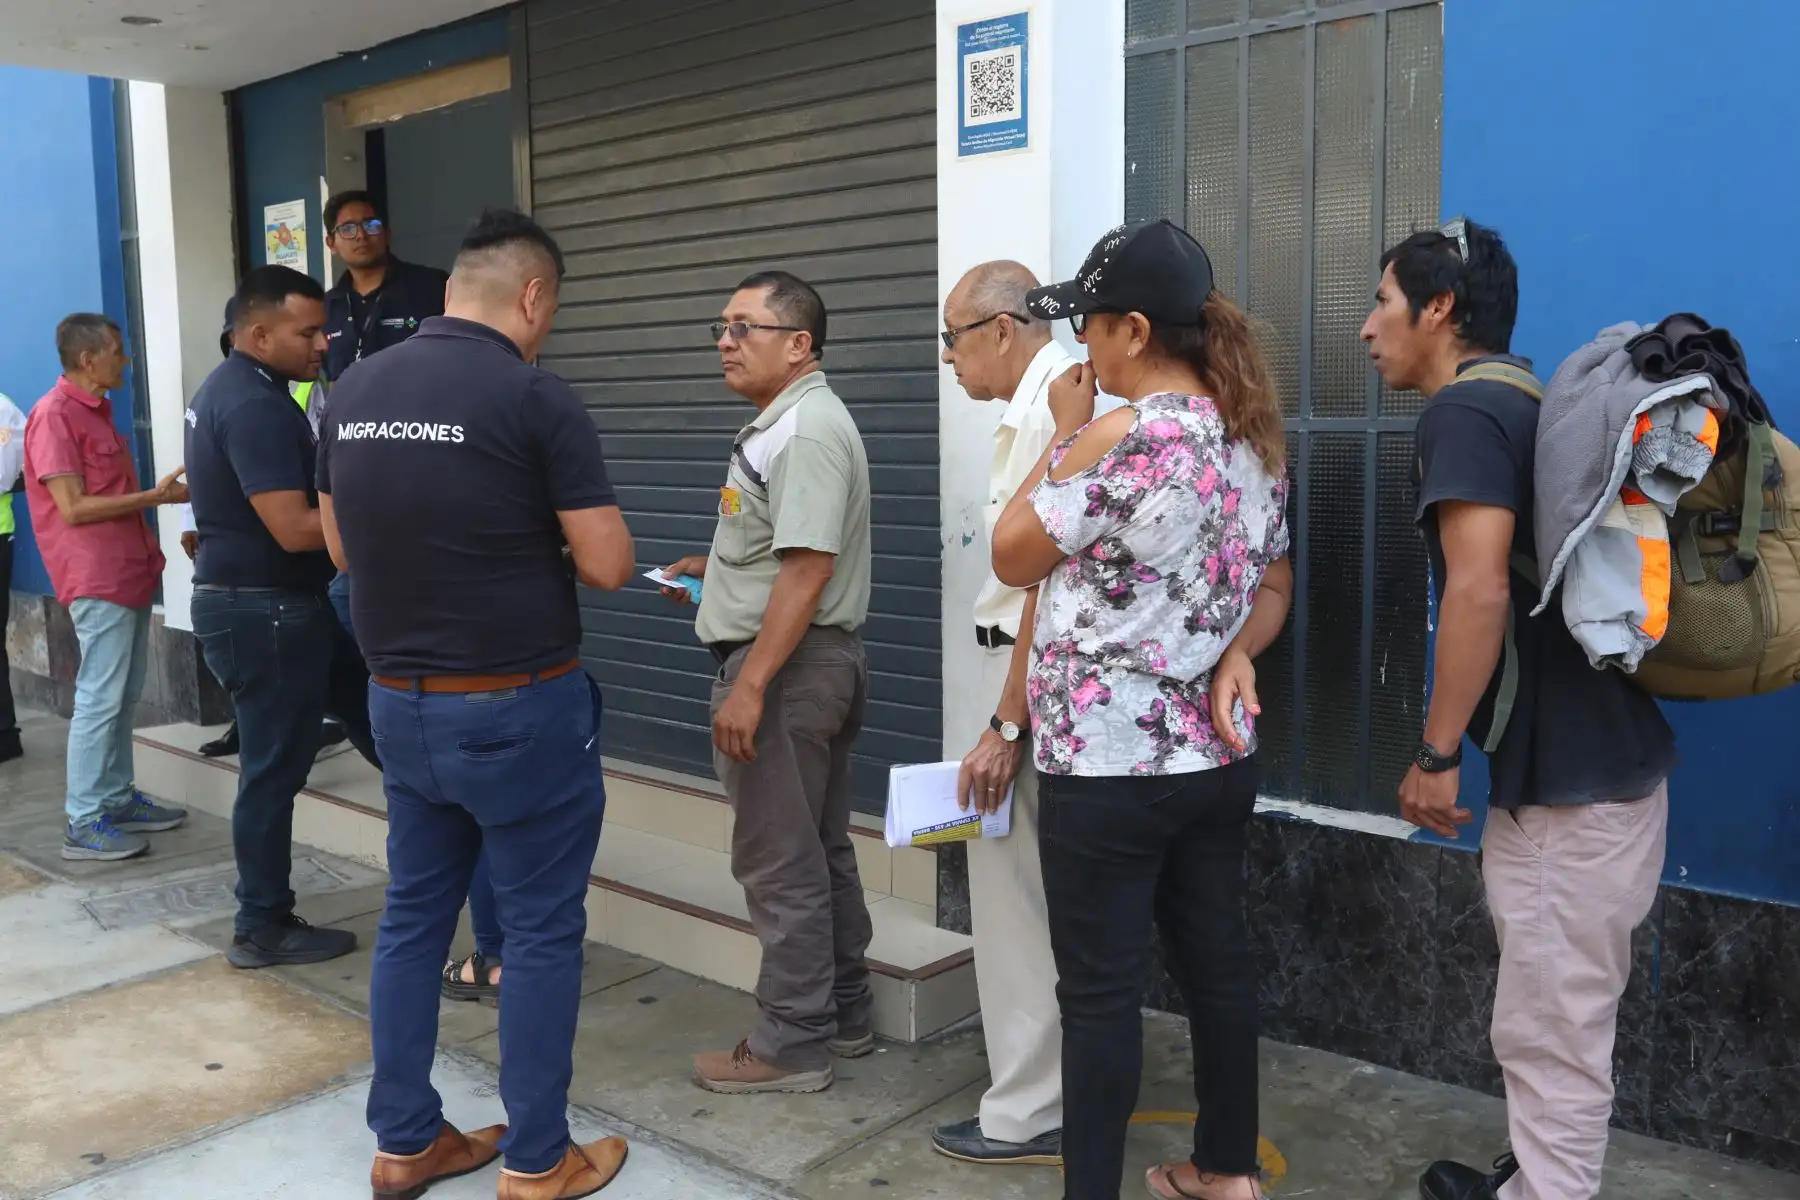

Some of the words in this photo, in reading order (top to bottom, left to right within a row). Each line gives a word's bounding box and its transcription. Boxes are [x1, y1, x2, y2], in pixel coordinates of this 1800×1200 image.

[1083, 268, 1103, 292] NYC
[1038, 295, 1061, 314] NYC
[338, 422, 464, 443] MIGRACIONES
